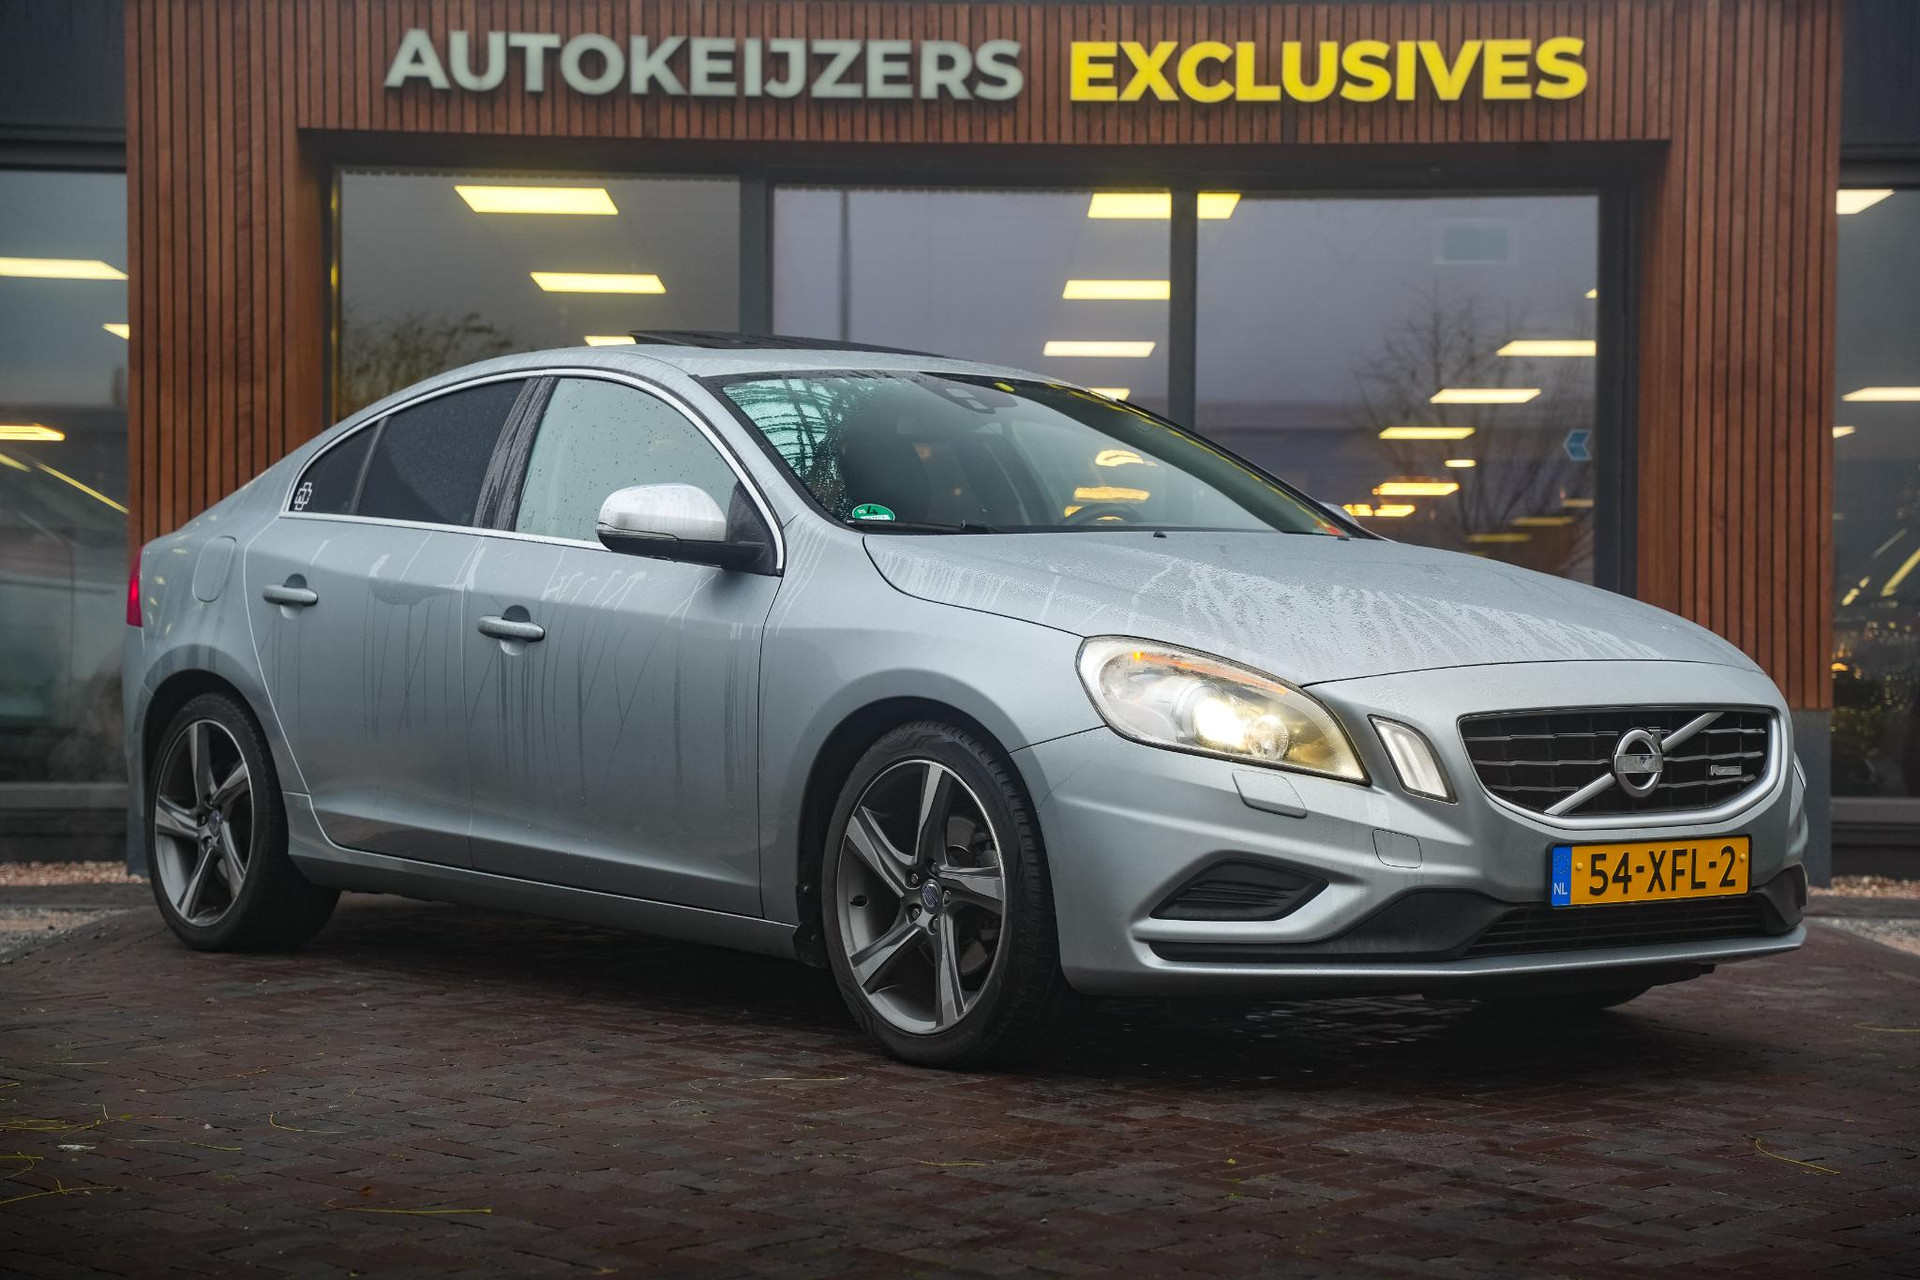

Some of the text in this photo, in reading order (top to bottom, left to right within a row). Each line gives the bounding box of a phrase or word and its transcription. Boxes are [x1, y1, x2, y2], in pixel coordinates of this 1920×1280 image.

[384, 29, 1588, 102] AUTOKEIJZERS EXCLUSIVES
[1553, 882, 1568, 896] NL
[1589, 845, 1737, 897] 54-XFL-2
